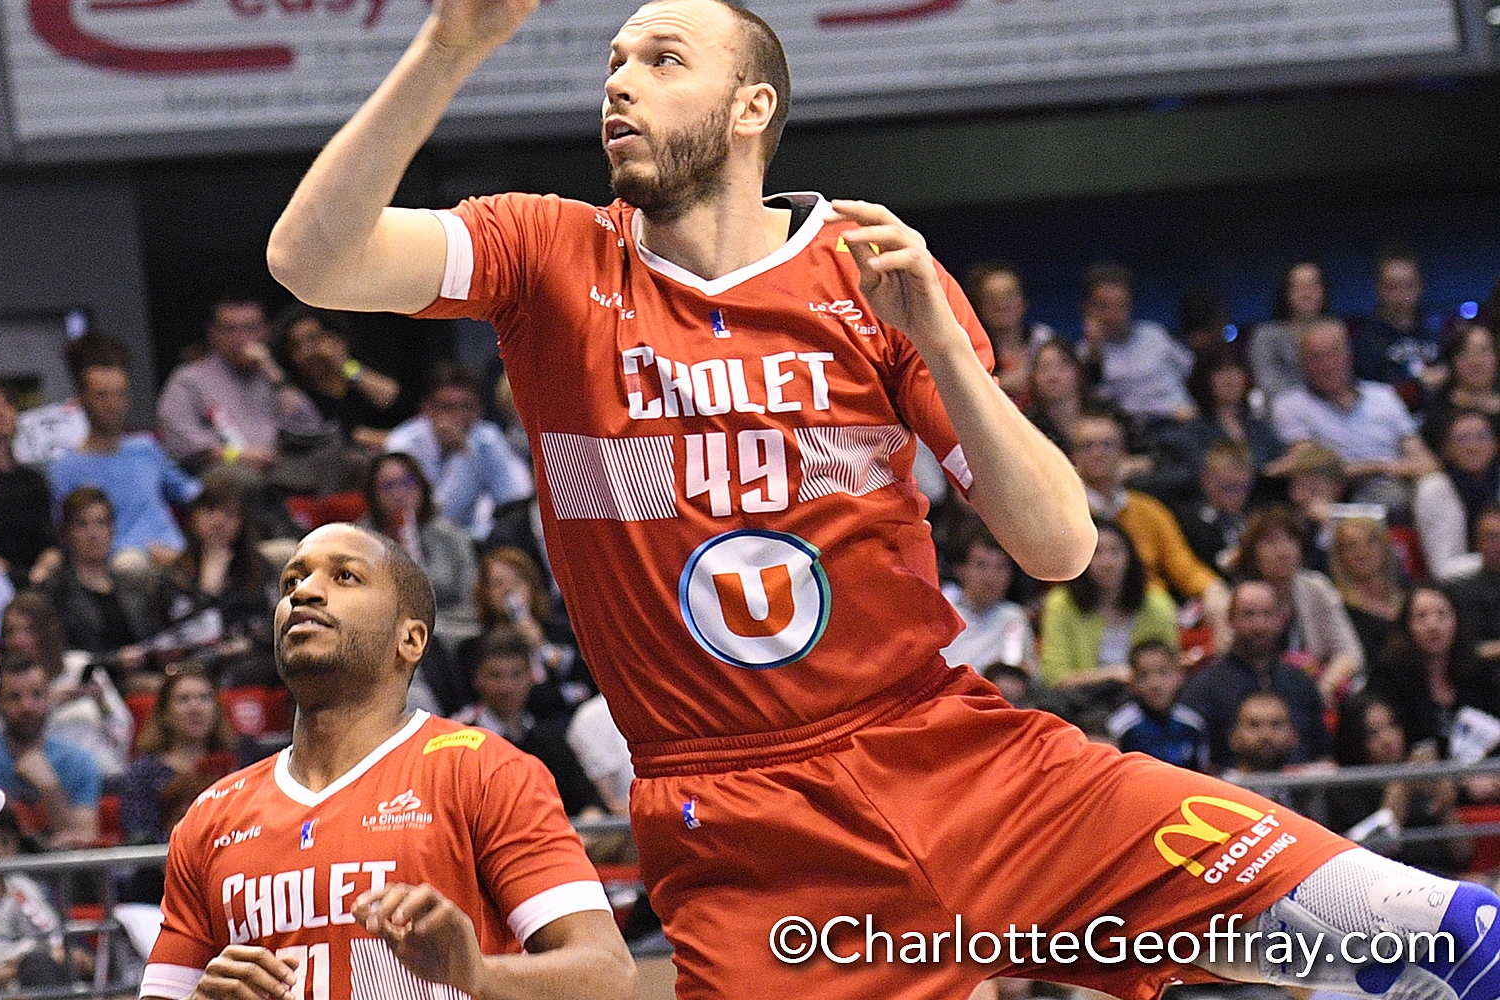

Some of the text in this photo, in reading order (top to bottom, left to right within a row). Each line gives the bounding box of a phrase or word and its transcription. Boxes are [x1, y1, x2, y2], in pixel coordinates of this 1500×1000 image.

[621, 345, 835, 420] CHOLET
[683, 429, 789, 518] 49
[712, 563, 795, 638] U
[1203, 813, 1280, 885] CHOLET
[1235, 832, 1298, 887] SPALDING
[222, 860, 397, 945] CHOLET
